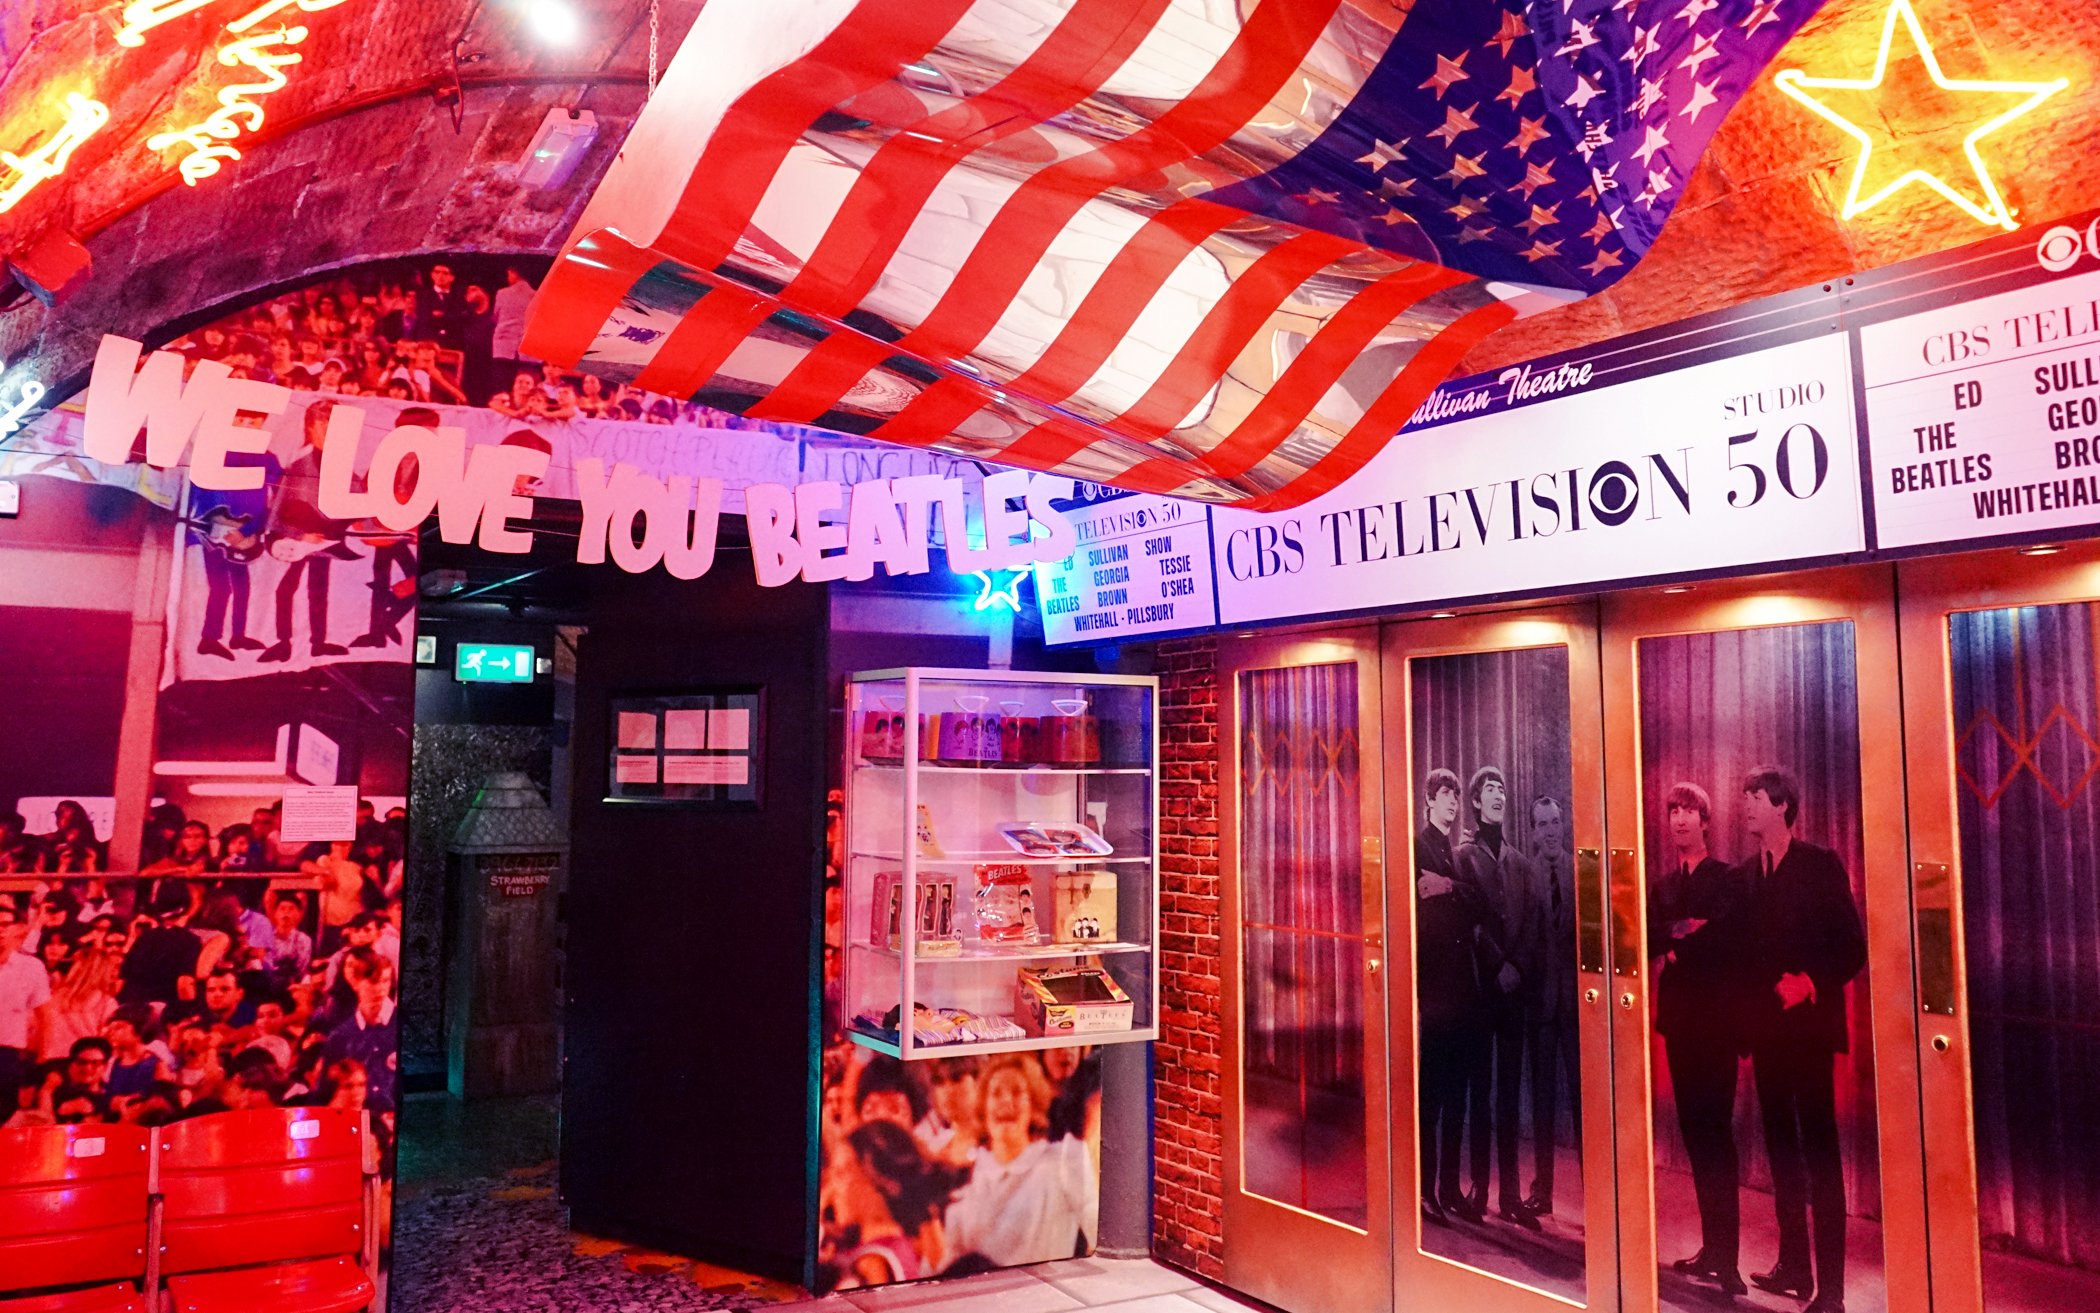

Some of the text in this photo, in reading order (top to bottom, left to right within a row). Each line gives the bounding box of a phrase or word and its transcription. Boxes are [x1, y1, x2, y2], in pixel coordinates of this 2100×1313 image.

[1922, 325, 1991, 366] CBS
[1402, 362, 1594, 428] ullivan Theatre
[1723, 380, 1825, 420] STUDIO
[1954, 355, 2100, 411] ED SULL
[1913, 396, 2100, 454] THE GEO
[84, 334, 291, 490] WE
[318, 405, 551, 554] LOVE
[577, 458, 722, 580] YOU
[744, 469, 1076, 587] BEATLES
[1891, 453, 1993, 494] BEATLES
[1075, 502, 1181, 540] TELEVISION 50
[1227, 423, 1829, 582] CBS TELEVISION 50
[1088, 544, 1129, 567] SULLIVAN
[1145, 536, 1172, 556] SHOW
[1052, 555, 1192, 594] THE GEORGIA TESSIE
[1046, 577, 1195, 615] BEATLES BROWN O'SHEA
[1074, 603, 1174, 632] WHITEHALL PILLSBURY
[490, 875, 551, 886] STRAWBERRY
[506, 886, 534, 896] FIELD
[988, 865, 1022, 881] BEATLES
